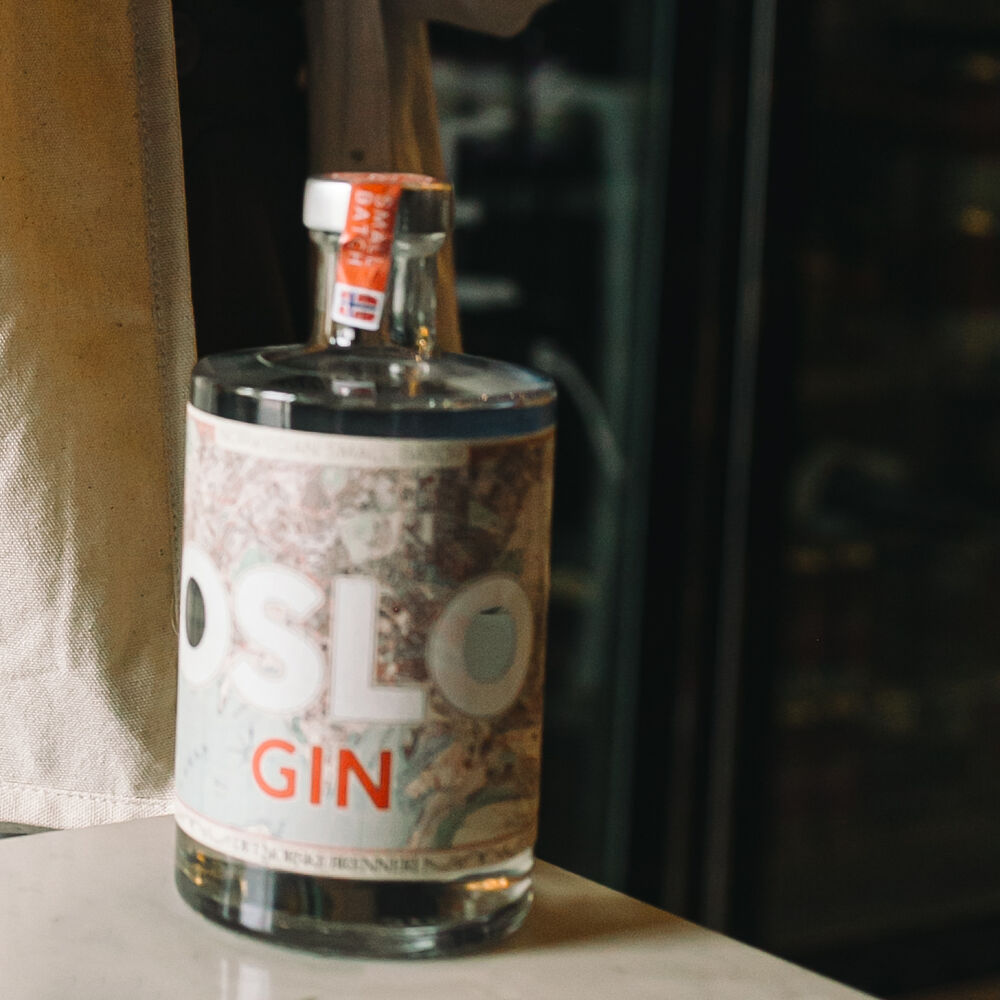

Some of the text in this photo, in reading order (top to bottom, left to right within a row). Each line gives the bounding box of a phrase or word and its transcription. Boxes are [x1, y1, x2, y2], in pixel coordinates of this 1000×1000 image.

[347, 189, 375, 268] BATCH
[180, 540, 535, 722] OSLO
[252, 738, 393, 812] GIN
